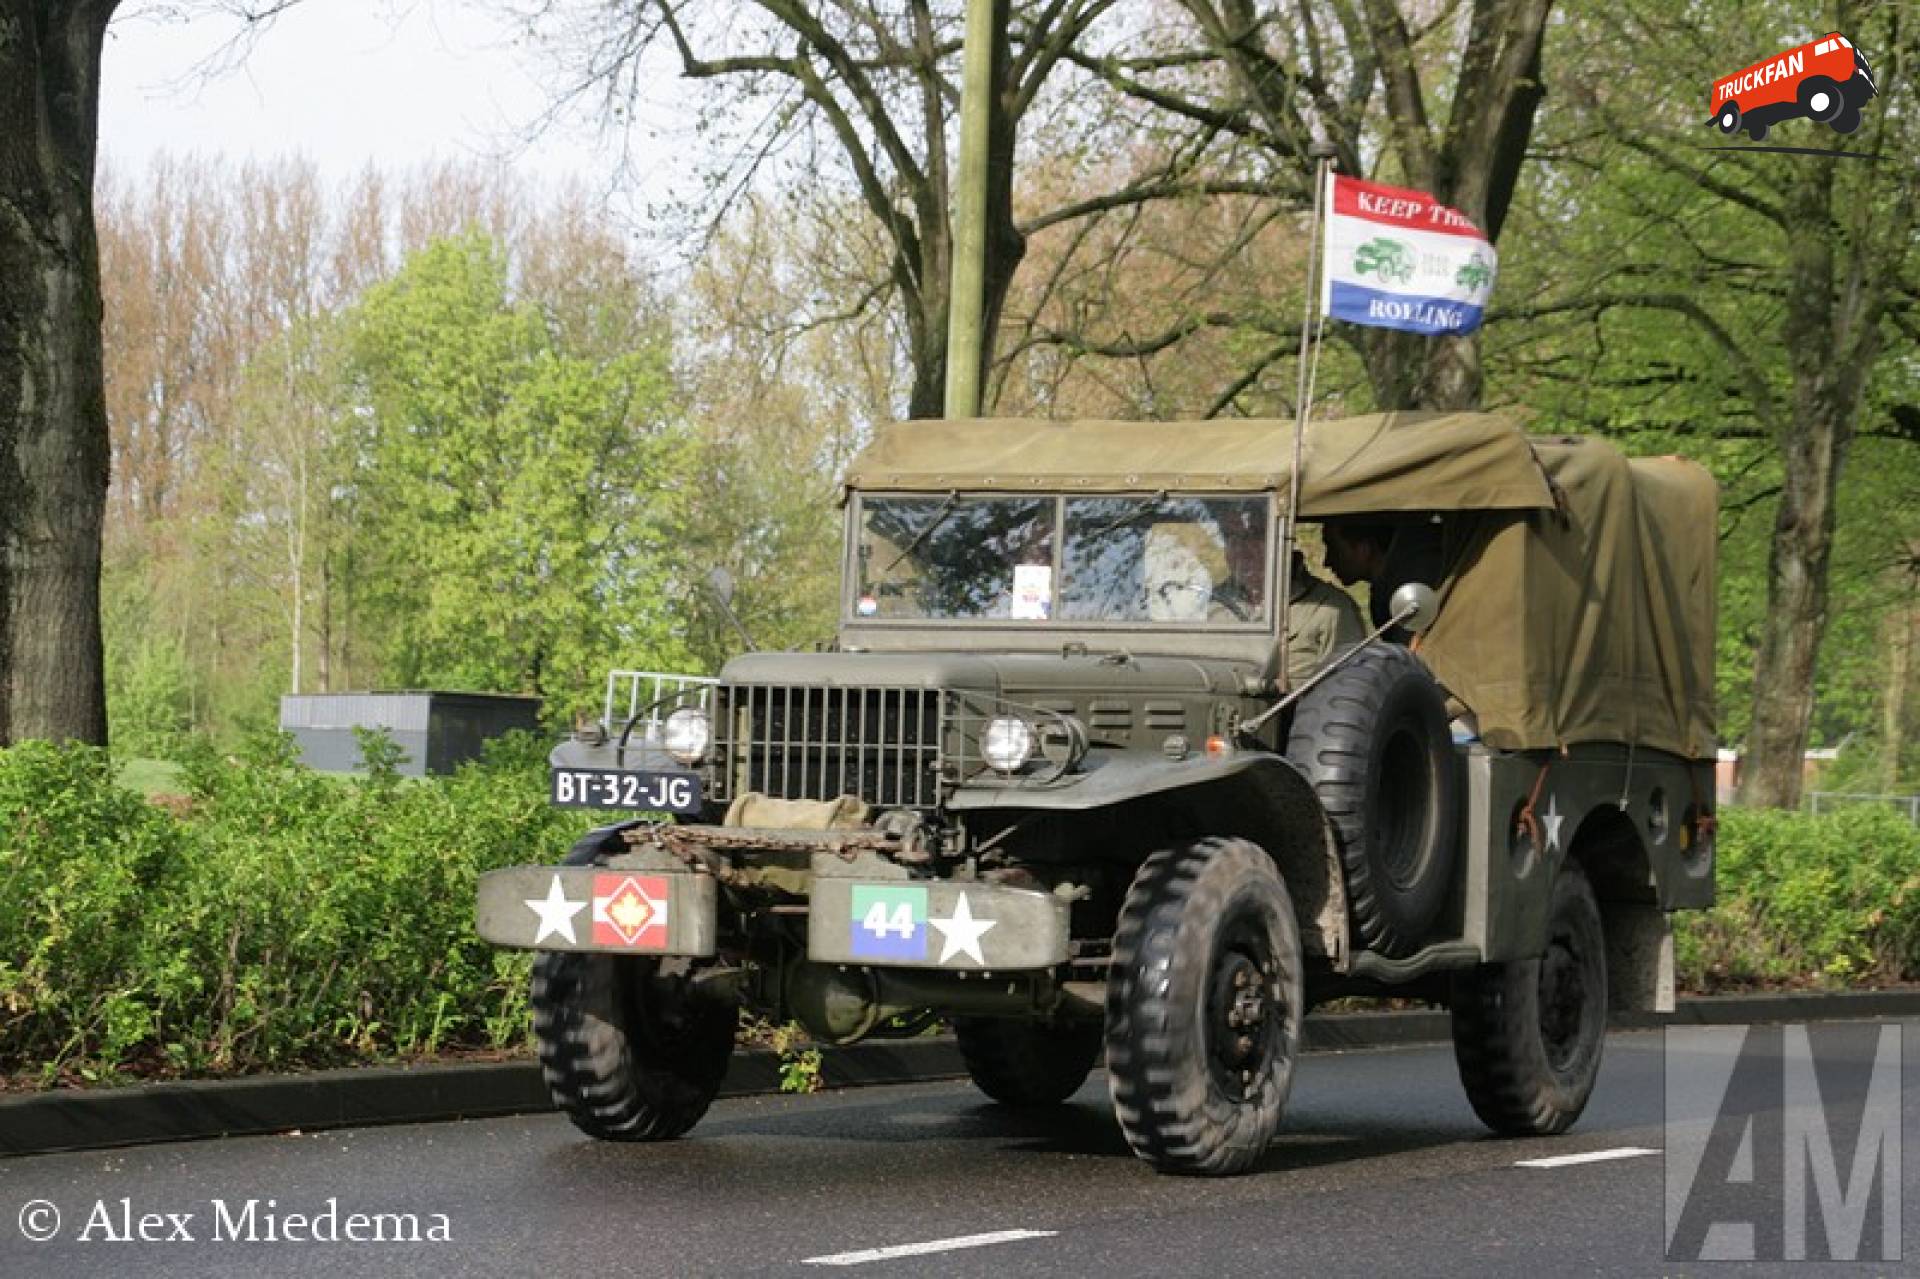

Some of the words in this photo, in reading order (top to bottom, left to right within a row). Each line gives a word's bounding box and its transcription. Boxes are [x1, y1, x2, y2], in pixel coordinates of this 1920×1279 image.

[1358, 192, 1421, 219] KEEP
[1369, 299, 1463, 328] ROLLING
[557, 772, 692, 807] BT-32-JG
[863, 901, 915, 939] 44
